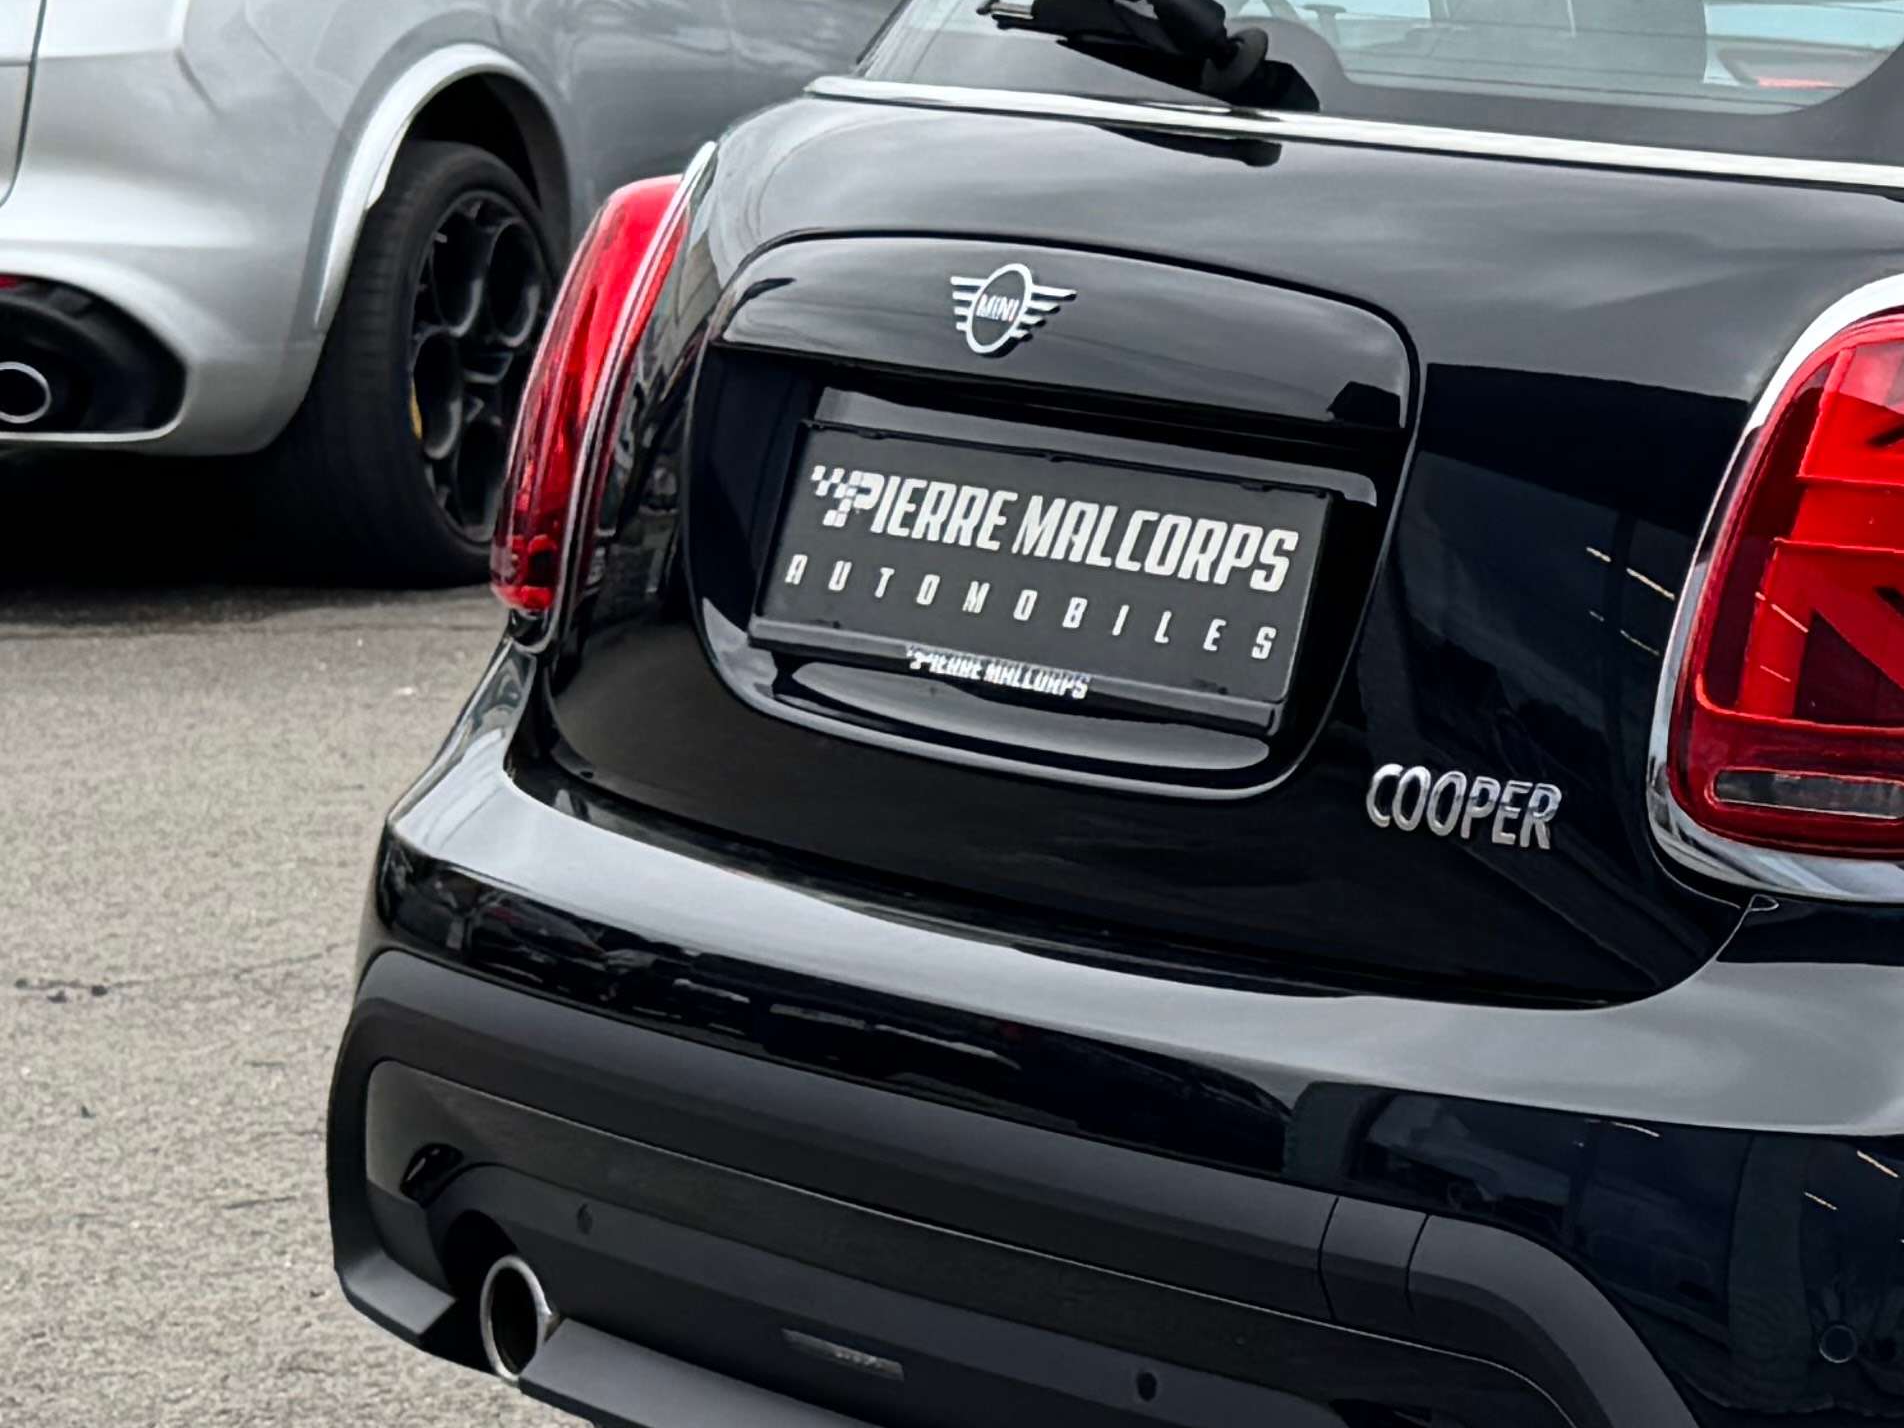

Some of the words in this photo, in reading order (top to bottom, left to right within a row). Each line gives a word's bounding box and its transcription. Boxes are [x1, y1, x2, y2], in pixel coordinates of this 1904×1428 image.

[976, 293, 1020, 323] MINI
[847, 469, 1018, 554] PIERRE
[1011, 493, 1299, 592] MALCORPS
[784, 552, 1278, 662] AUTOMOBILES
[1366, 763, 1562, 850] COOPER
